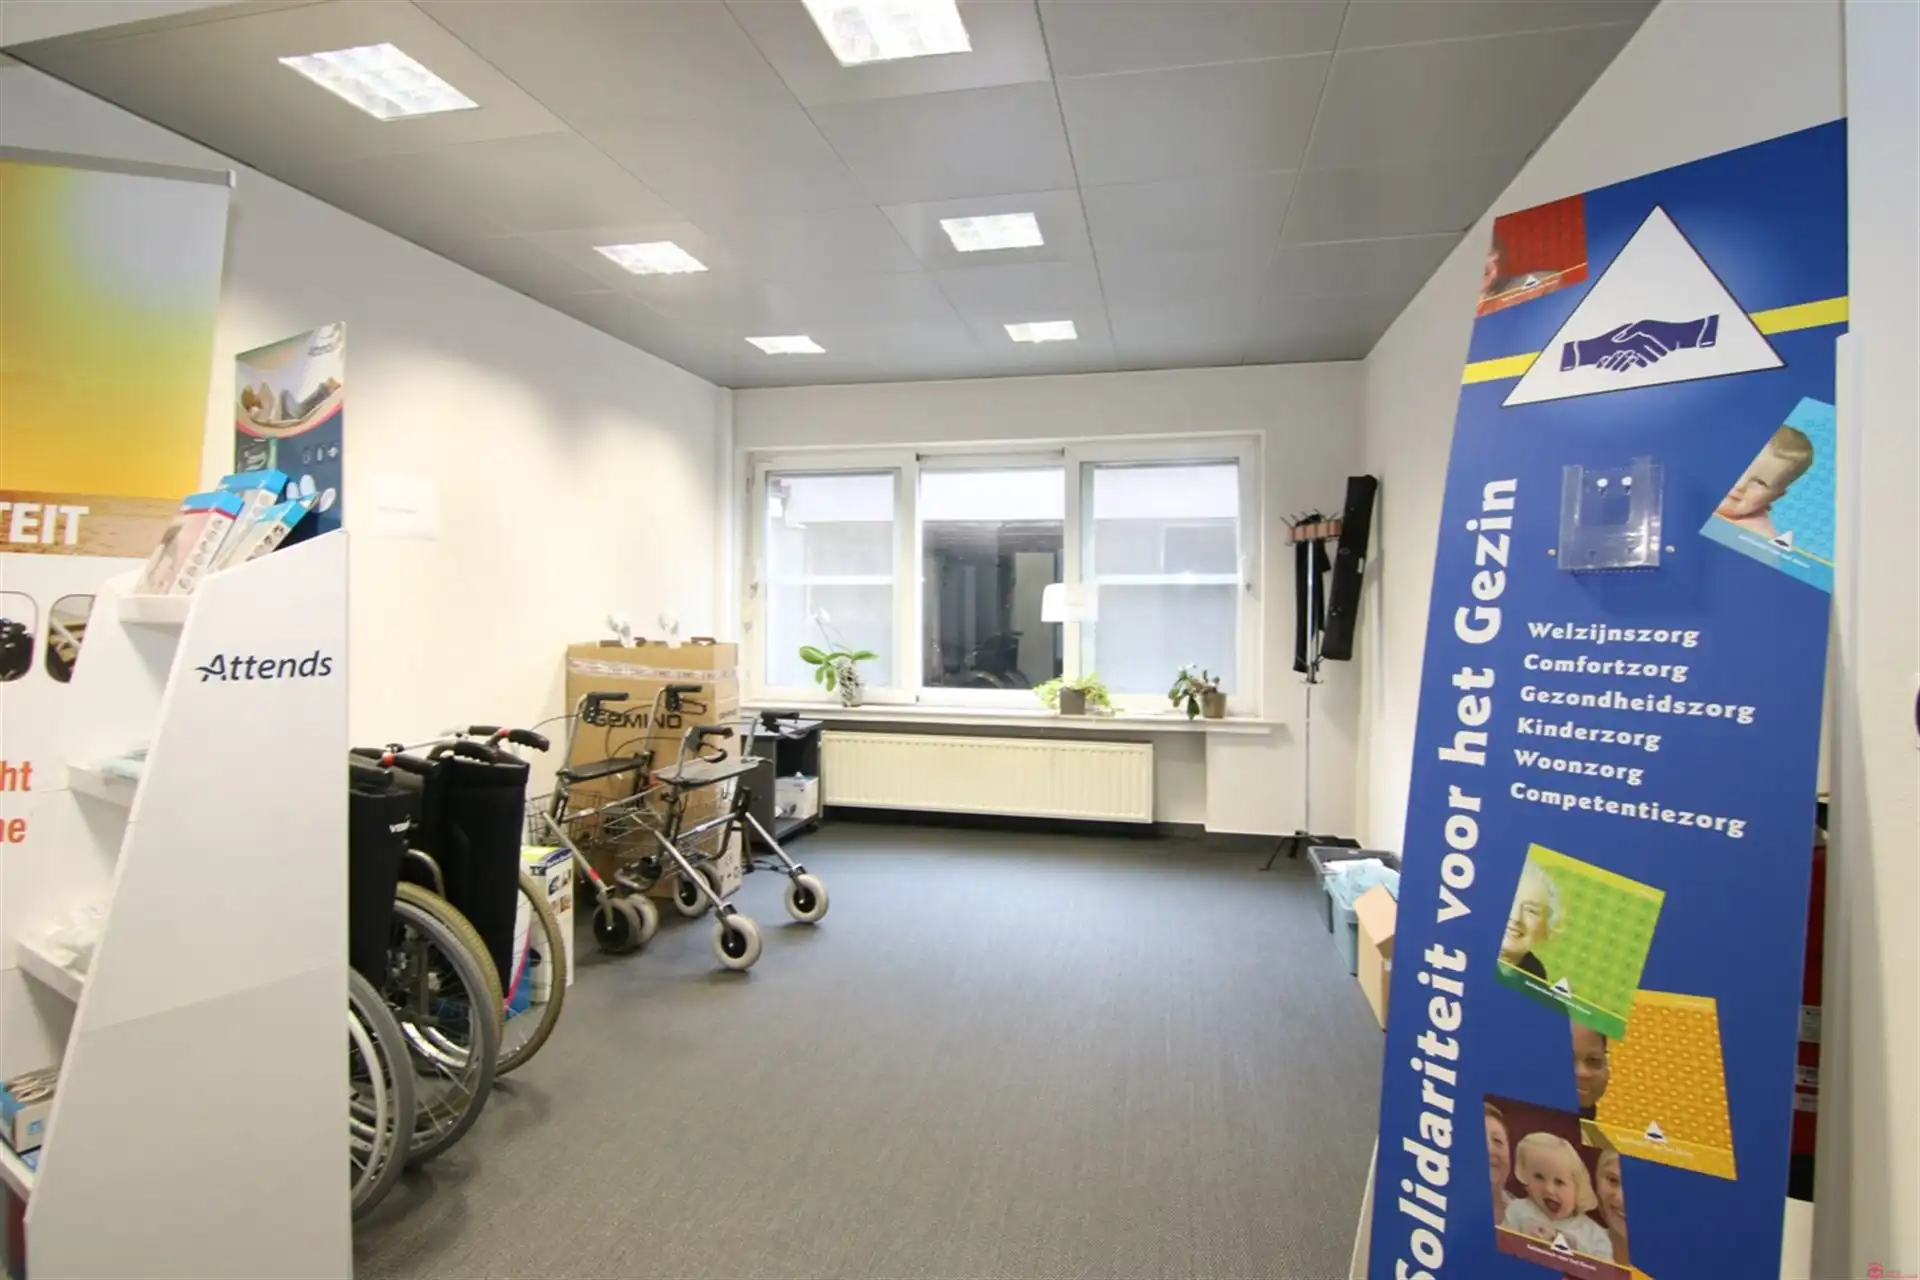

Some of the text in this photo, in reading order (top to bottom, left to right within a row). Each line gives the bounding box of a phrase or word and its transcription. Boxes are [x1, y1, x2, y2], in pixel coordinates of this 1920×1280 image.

[1454, 477, 1518, 645] Gezin
[1528, 622, 1700, 648] Welzijnszorg
[196, 650, 333, 682] Attends
[1523, 653, 1689, 683] Comfortzorg
[1438, 666, 1495, 767] het
[1520, 685, 1756, 725] Gezondheidszorg
[1516, 716, 1662, 752] Kinderzorg
[1514, 748, 1644, 786] Woonzorg
[1510, 782, 1747, 839] Competentiezorg
[1436, 785, 1481, 923] voor
